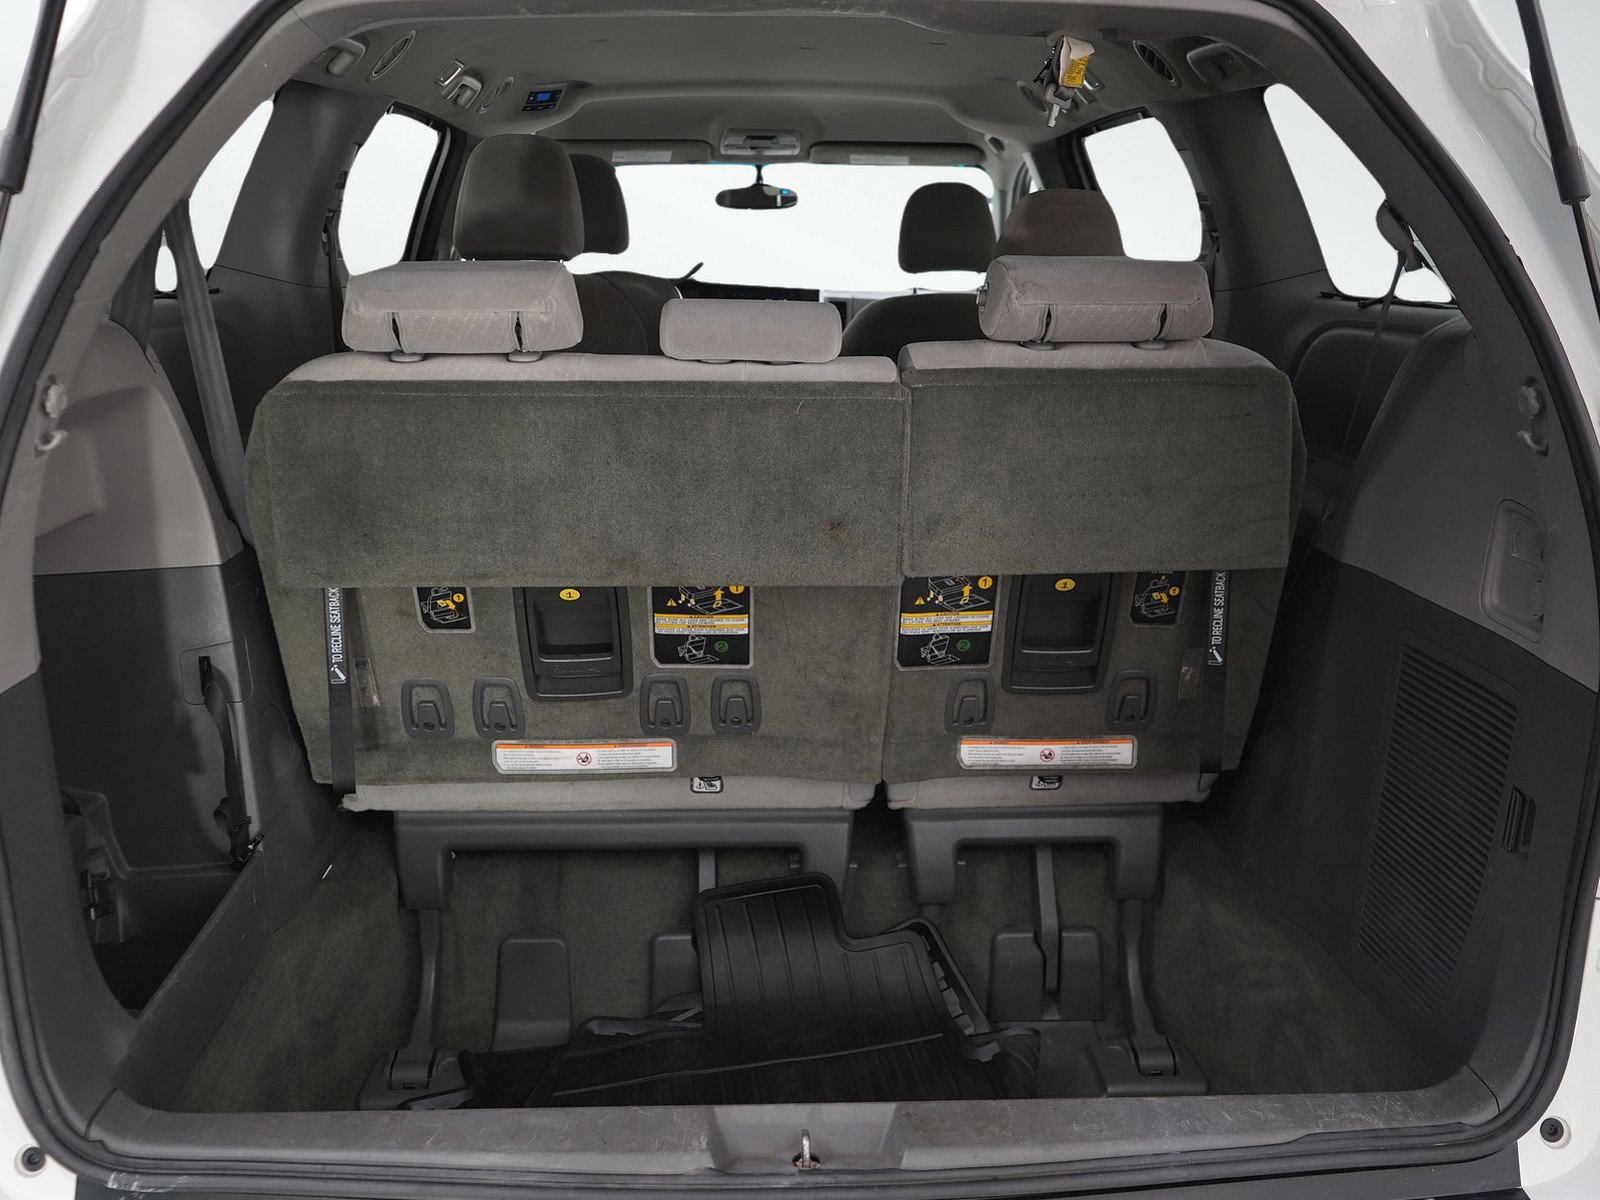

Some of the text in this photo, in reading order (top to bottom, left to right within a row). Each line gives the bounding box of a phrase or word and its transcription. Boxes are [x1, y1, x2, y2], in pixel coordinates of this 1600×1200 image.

[328, 587, 343, 663] TO RECLINE SEATBACK
[960, 640, 967, 649] 2
[1211, 571, 1227, 645] TO RECLINE SEATBACK
